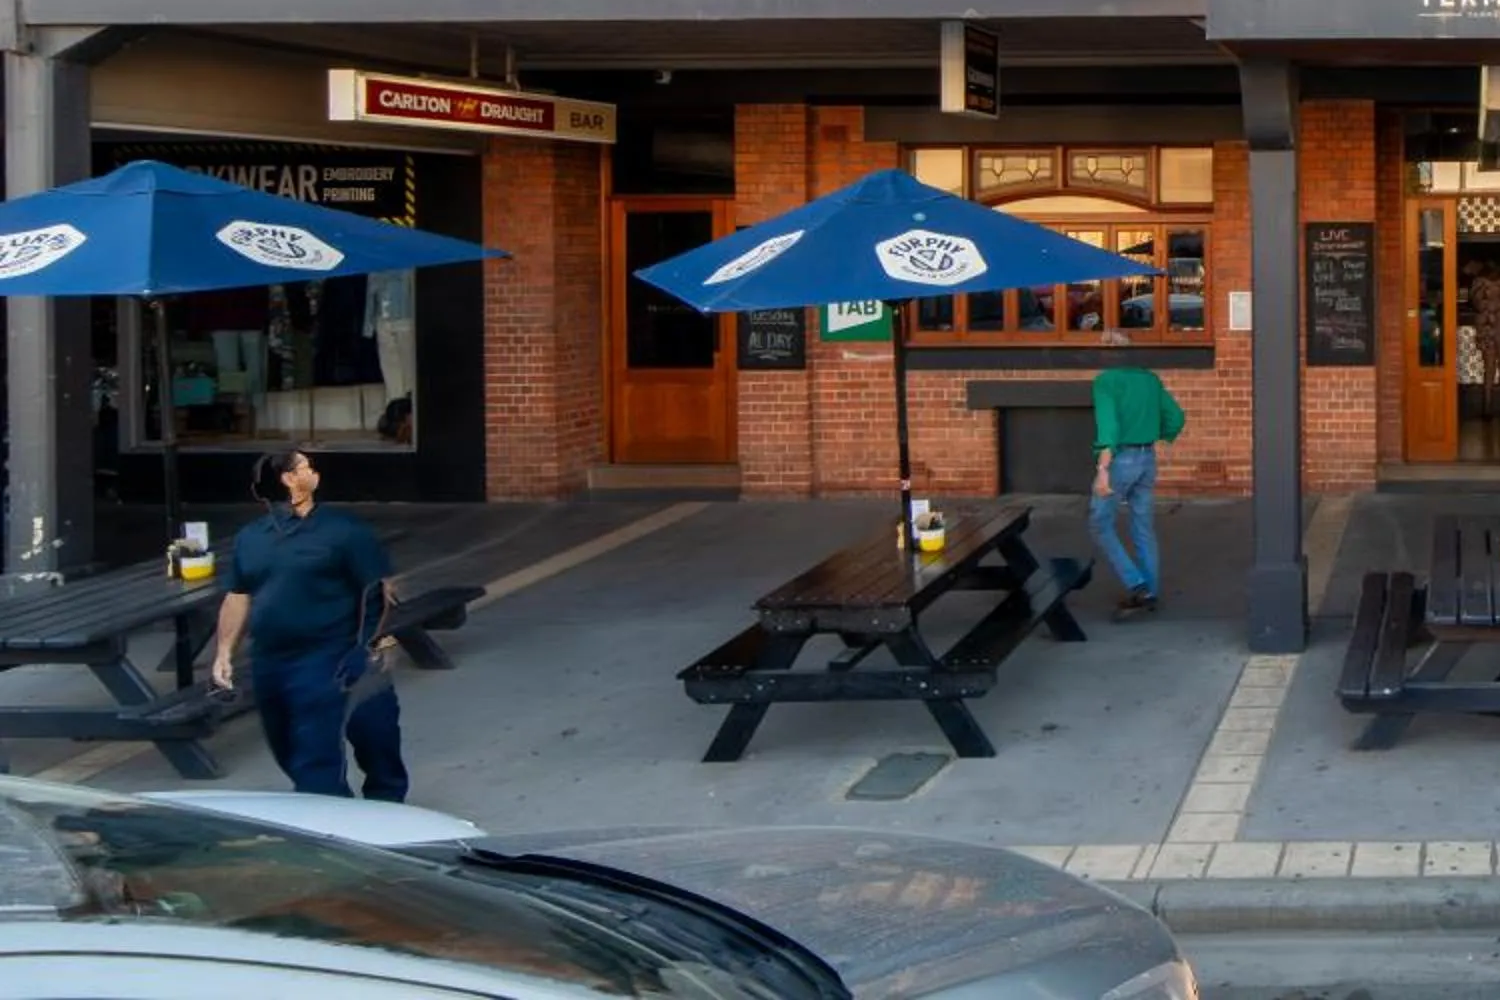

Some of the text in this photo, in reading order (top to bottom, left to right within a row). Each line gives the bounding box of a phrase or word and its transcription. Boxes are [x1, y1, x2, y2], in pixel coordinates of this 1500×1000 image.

[379, 89, 605, 131] CARLTON DRAUGHT BAR
[322, 187, 375, 202] PRINTING
[888, 237, 966, 258] FURPHY
[836, 300, 878, 315] TAB
